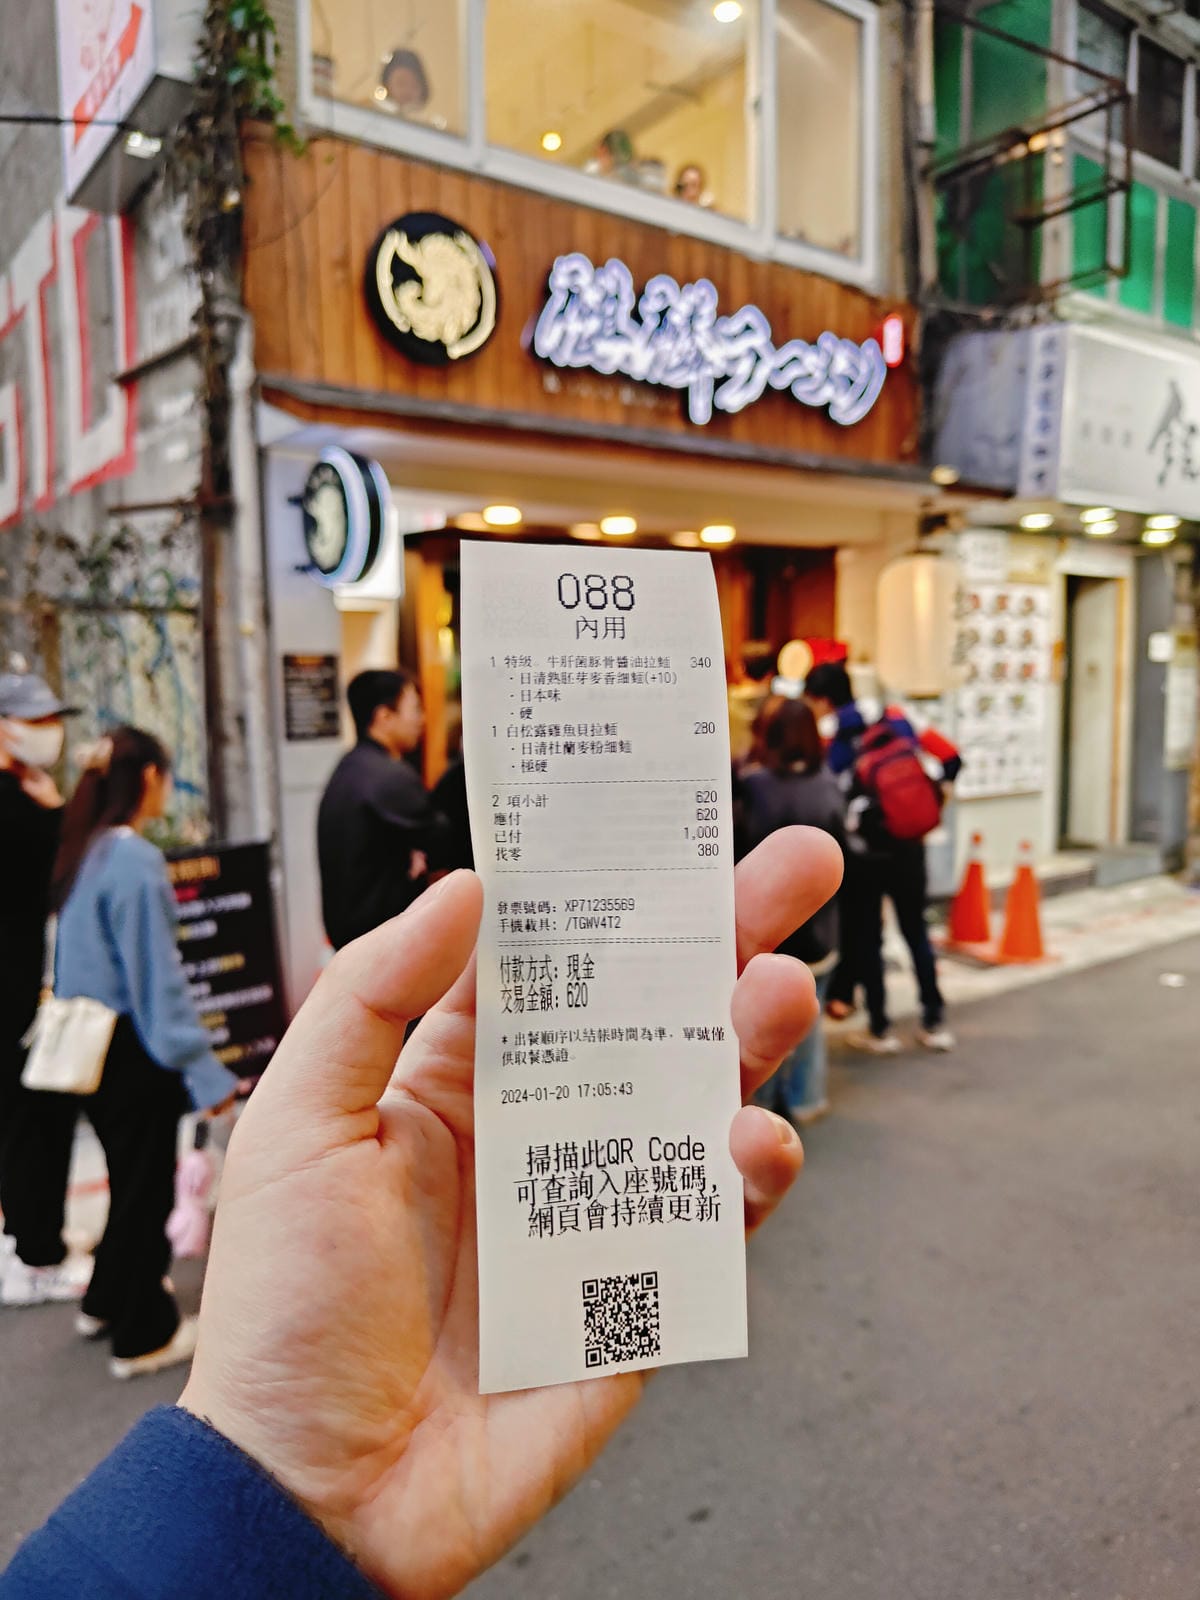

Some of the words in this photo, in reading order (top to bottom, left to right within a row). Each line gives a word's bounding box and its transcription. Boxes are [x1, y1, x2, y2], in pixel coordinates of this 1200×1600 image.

[558, 573, 635, 611] 088
[576, 615, 625, 640] 內用
[490, 656, 497, 668] 1
[690, 656, 712, 669] 340
[491, 726, 498, 738] 1
[694, 722, 716, 735] 280
[492, 795, 500, 807] 2
[507, 793, 550, 808] 項小計
[696, 790, 718, 803] 620
[494, 812, 522, 826] 應付
[696, 808, 718, 821] 620
[495, 830, 522, 843] 已付
[683, 826, 719, 840] 1,000
[495, 847, 522, 861] 找零
[697, 843, 719, 857] 380
[564, 898, 636, 912] XP71235569
[566, 953, 595, 981] 現金
[566, 982, 589, 1008] 620
[501, 1084, 570, 1104] 2024-01-20
[577, 1081, 634, 1099] 17:05:43
[526, 1137, 634, 1177] 掃描此QR
[648, 1134, 705, 1162] Code
[528, 1192, 722, 1238] 網頁會持續更新
